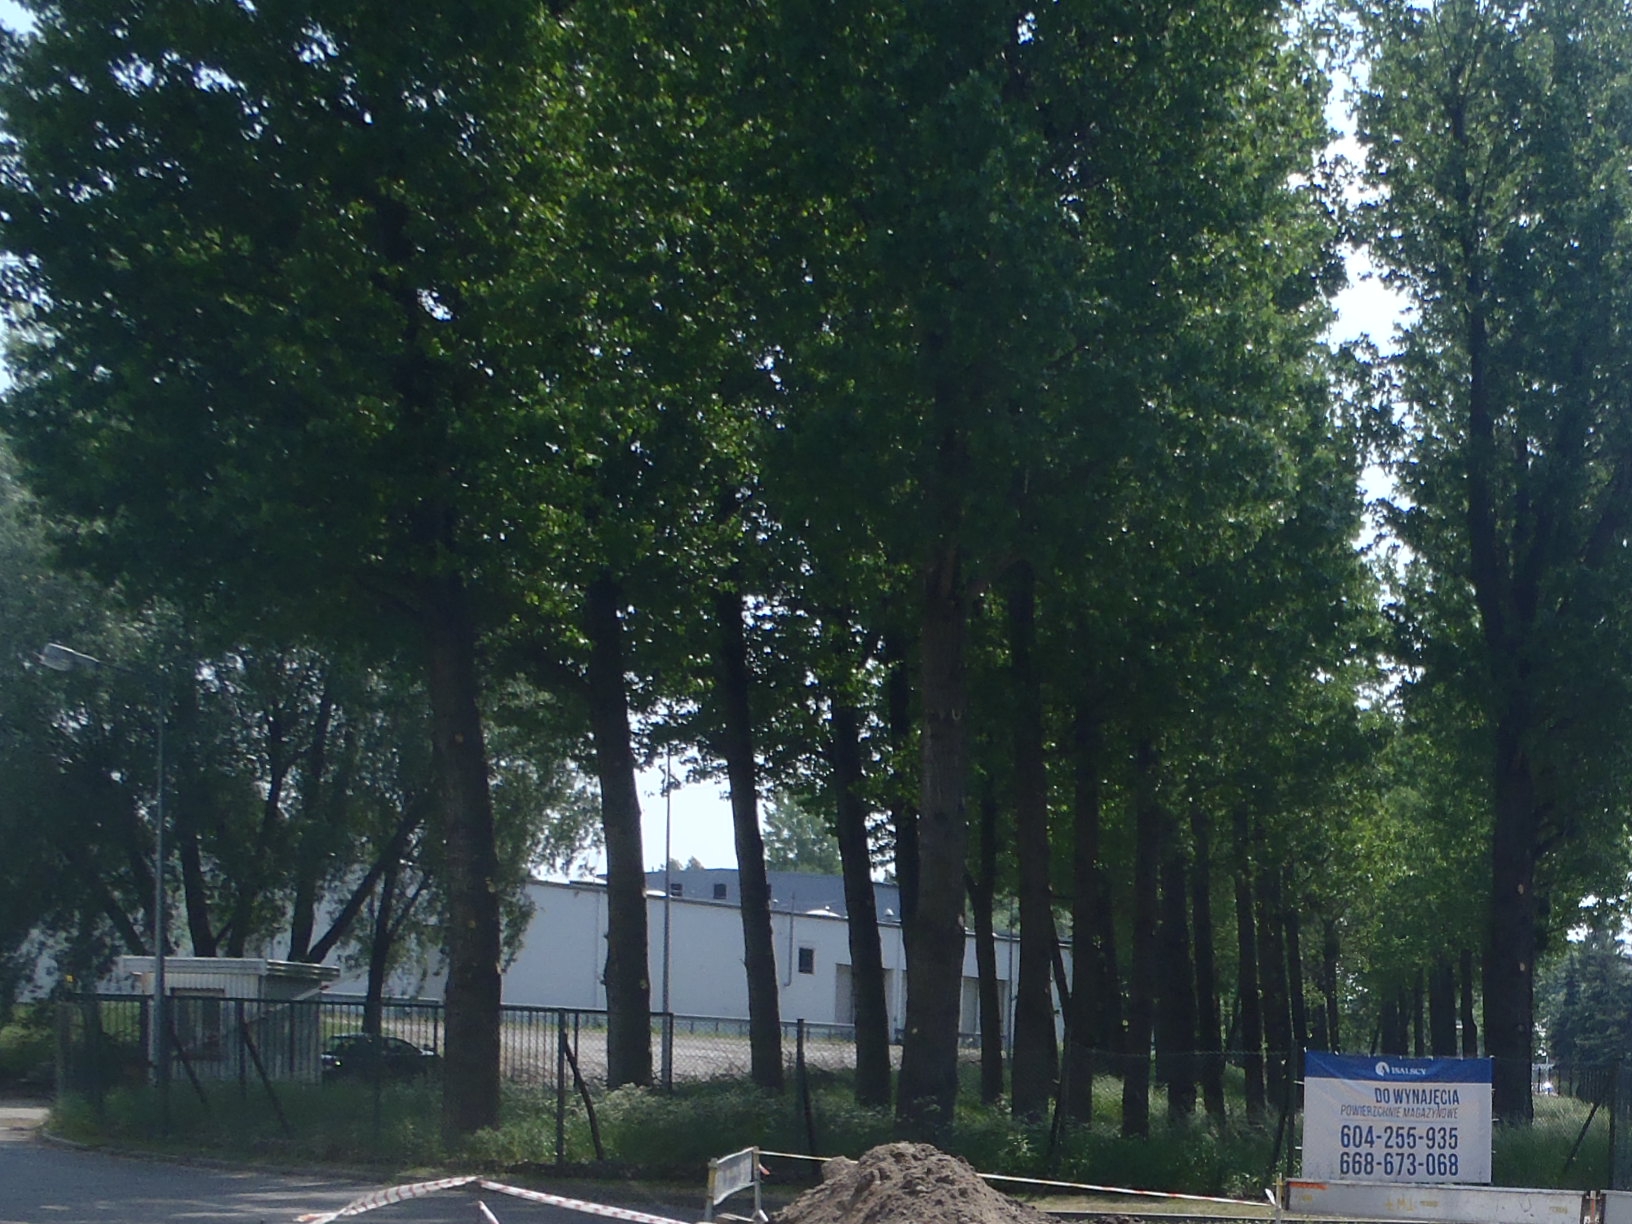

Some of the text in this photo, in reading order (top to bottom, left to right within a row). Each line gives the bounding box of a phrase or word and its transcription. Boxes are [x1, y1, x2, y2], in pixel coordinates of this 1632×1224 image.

[1375, 1088, 1460, 1108] DO WYNAJĘCIA
[1340, 1104, 1458, 1119] POWIERZCHNIE MAGAZYNOWE
[1340, 1124, 1458, 1150] 604-255-935
[1340, 1152, 1459, 1176] 668-673-068
